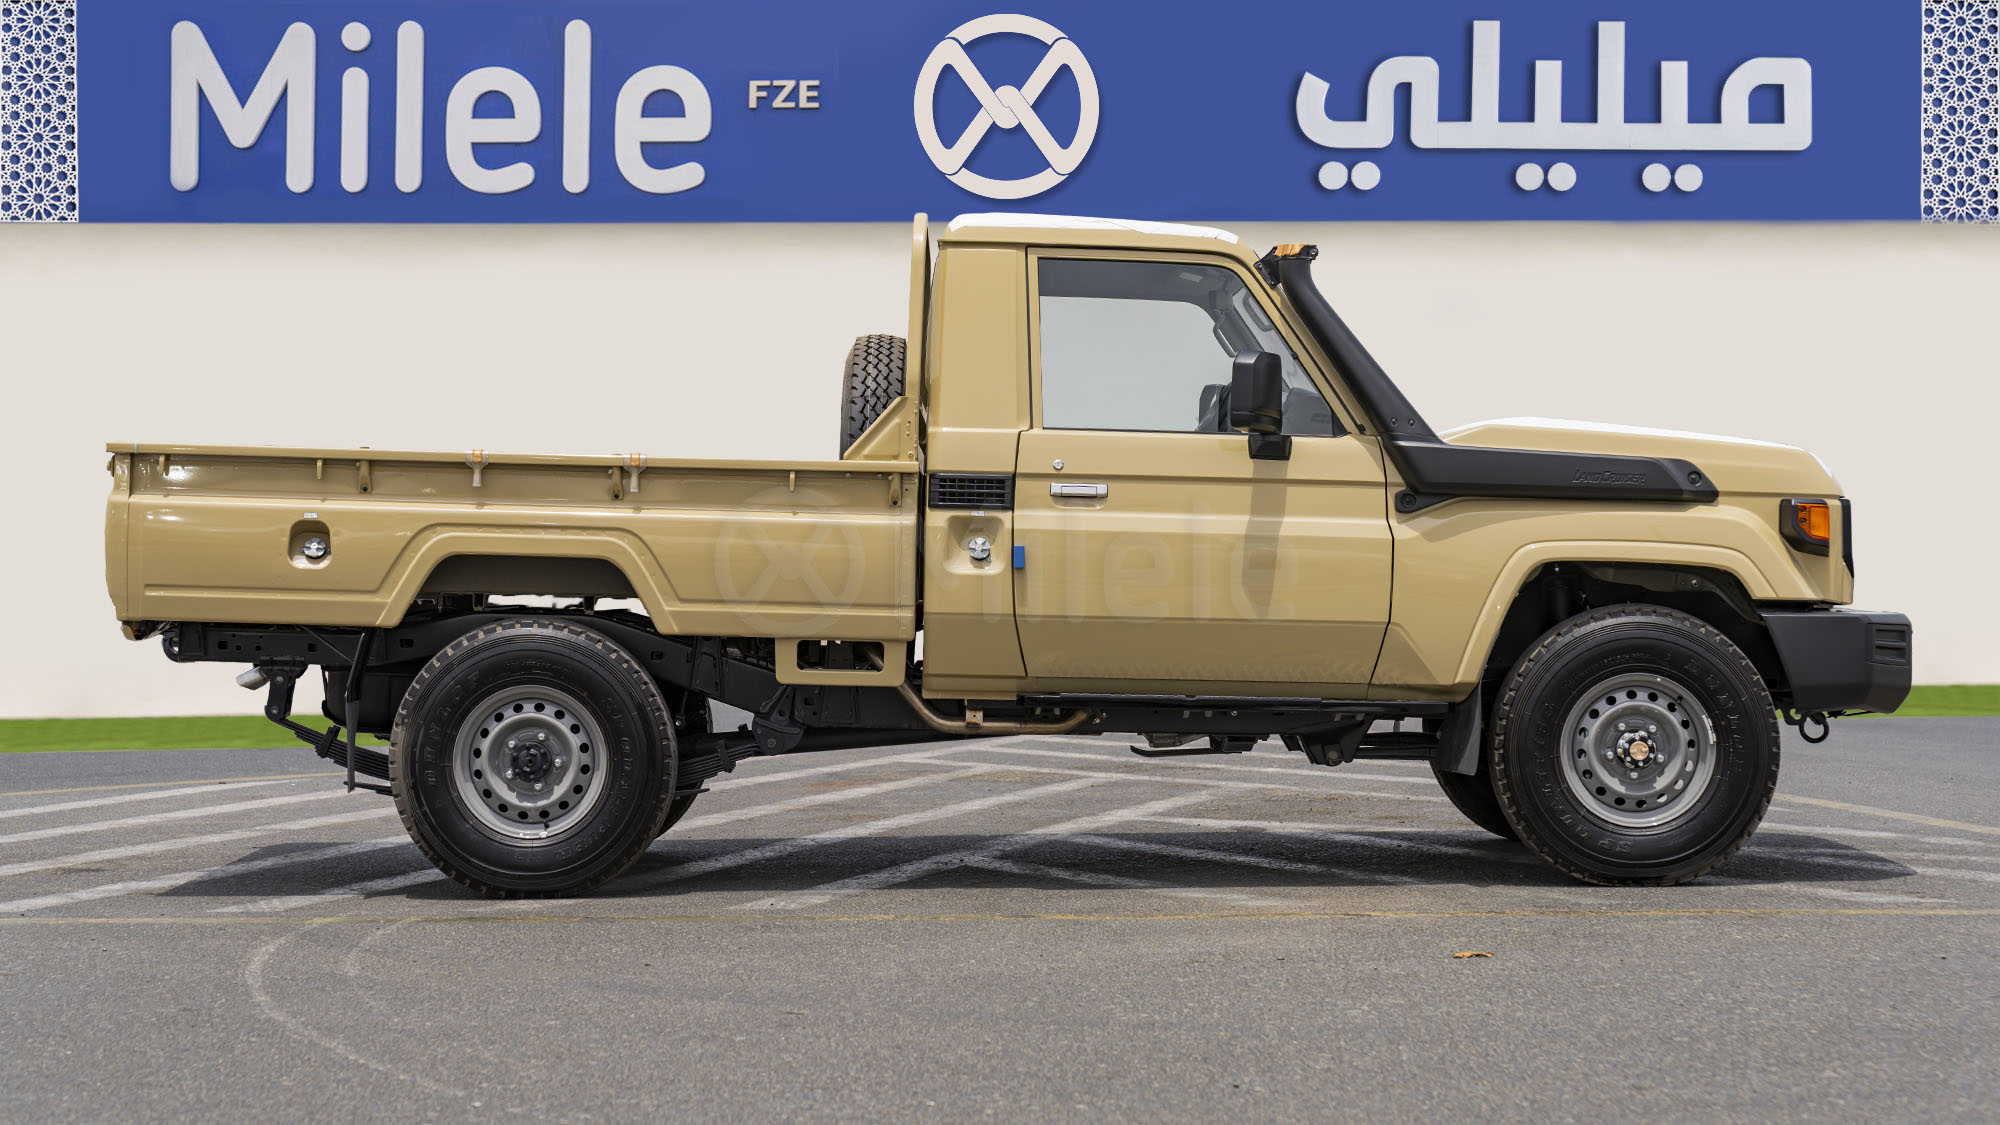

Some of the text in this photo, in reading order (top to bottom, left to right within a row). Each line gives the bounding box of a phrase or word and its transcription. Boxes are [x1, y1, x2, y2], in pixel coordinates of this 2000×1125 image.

[170, 19, 820, 194] Milele FZE
[1296, 20, 1812, 191] ميليلي
